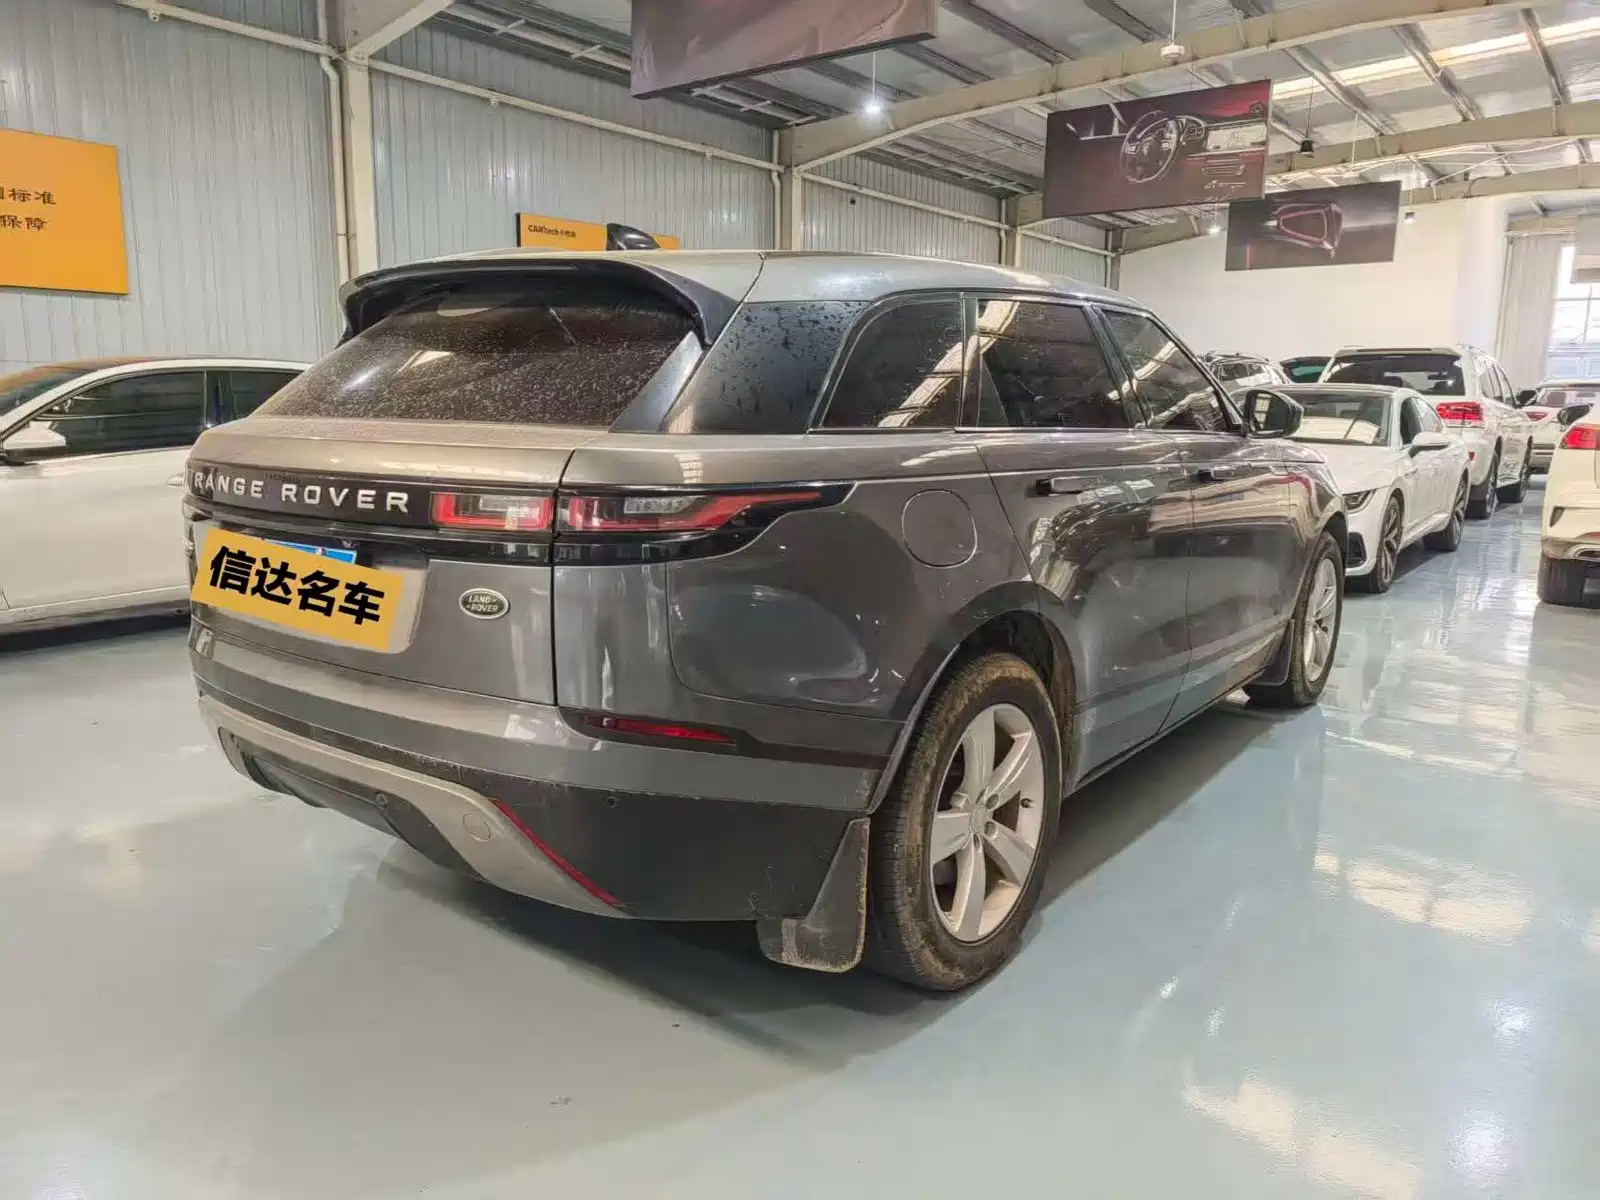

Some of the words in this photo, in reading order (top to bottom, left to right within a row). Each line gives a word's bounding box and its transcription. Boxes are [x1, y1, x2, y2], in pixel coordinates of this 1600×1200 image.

[0, 186, 57, 205] 标准
[0, 214, 48, 231] 保障
[194, 471, 264, 498] RANGE
[281, 483, 409, 513] ROVER
